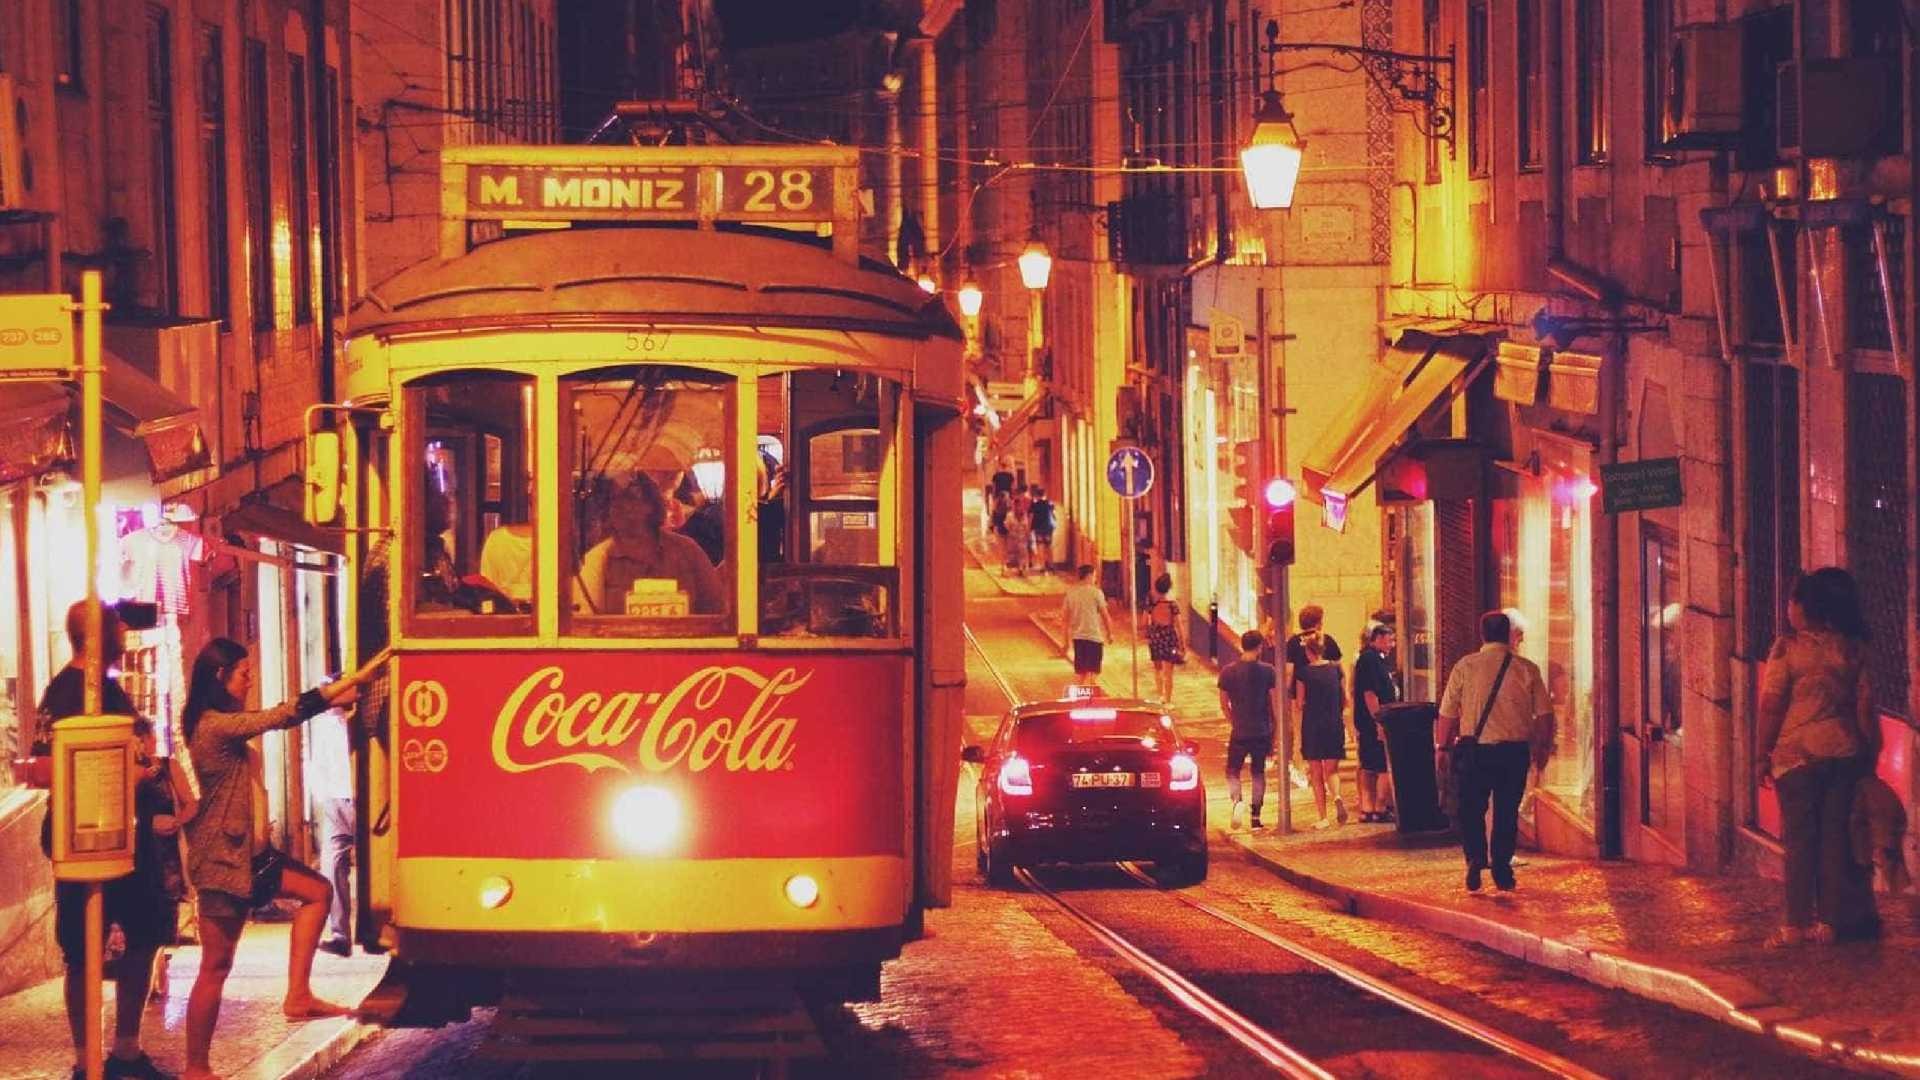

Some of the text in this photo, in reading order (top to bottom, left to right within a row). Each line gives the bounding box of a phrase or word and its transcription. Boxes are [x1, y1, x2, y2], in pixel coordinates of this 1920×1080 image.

[480, 175, 684, 208] M. MONIZ
[744, 169, 813, 212] 28
[625, 328, 671, 351] 567
[492, 666, 813, 773] Coca-Cola
